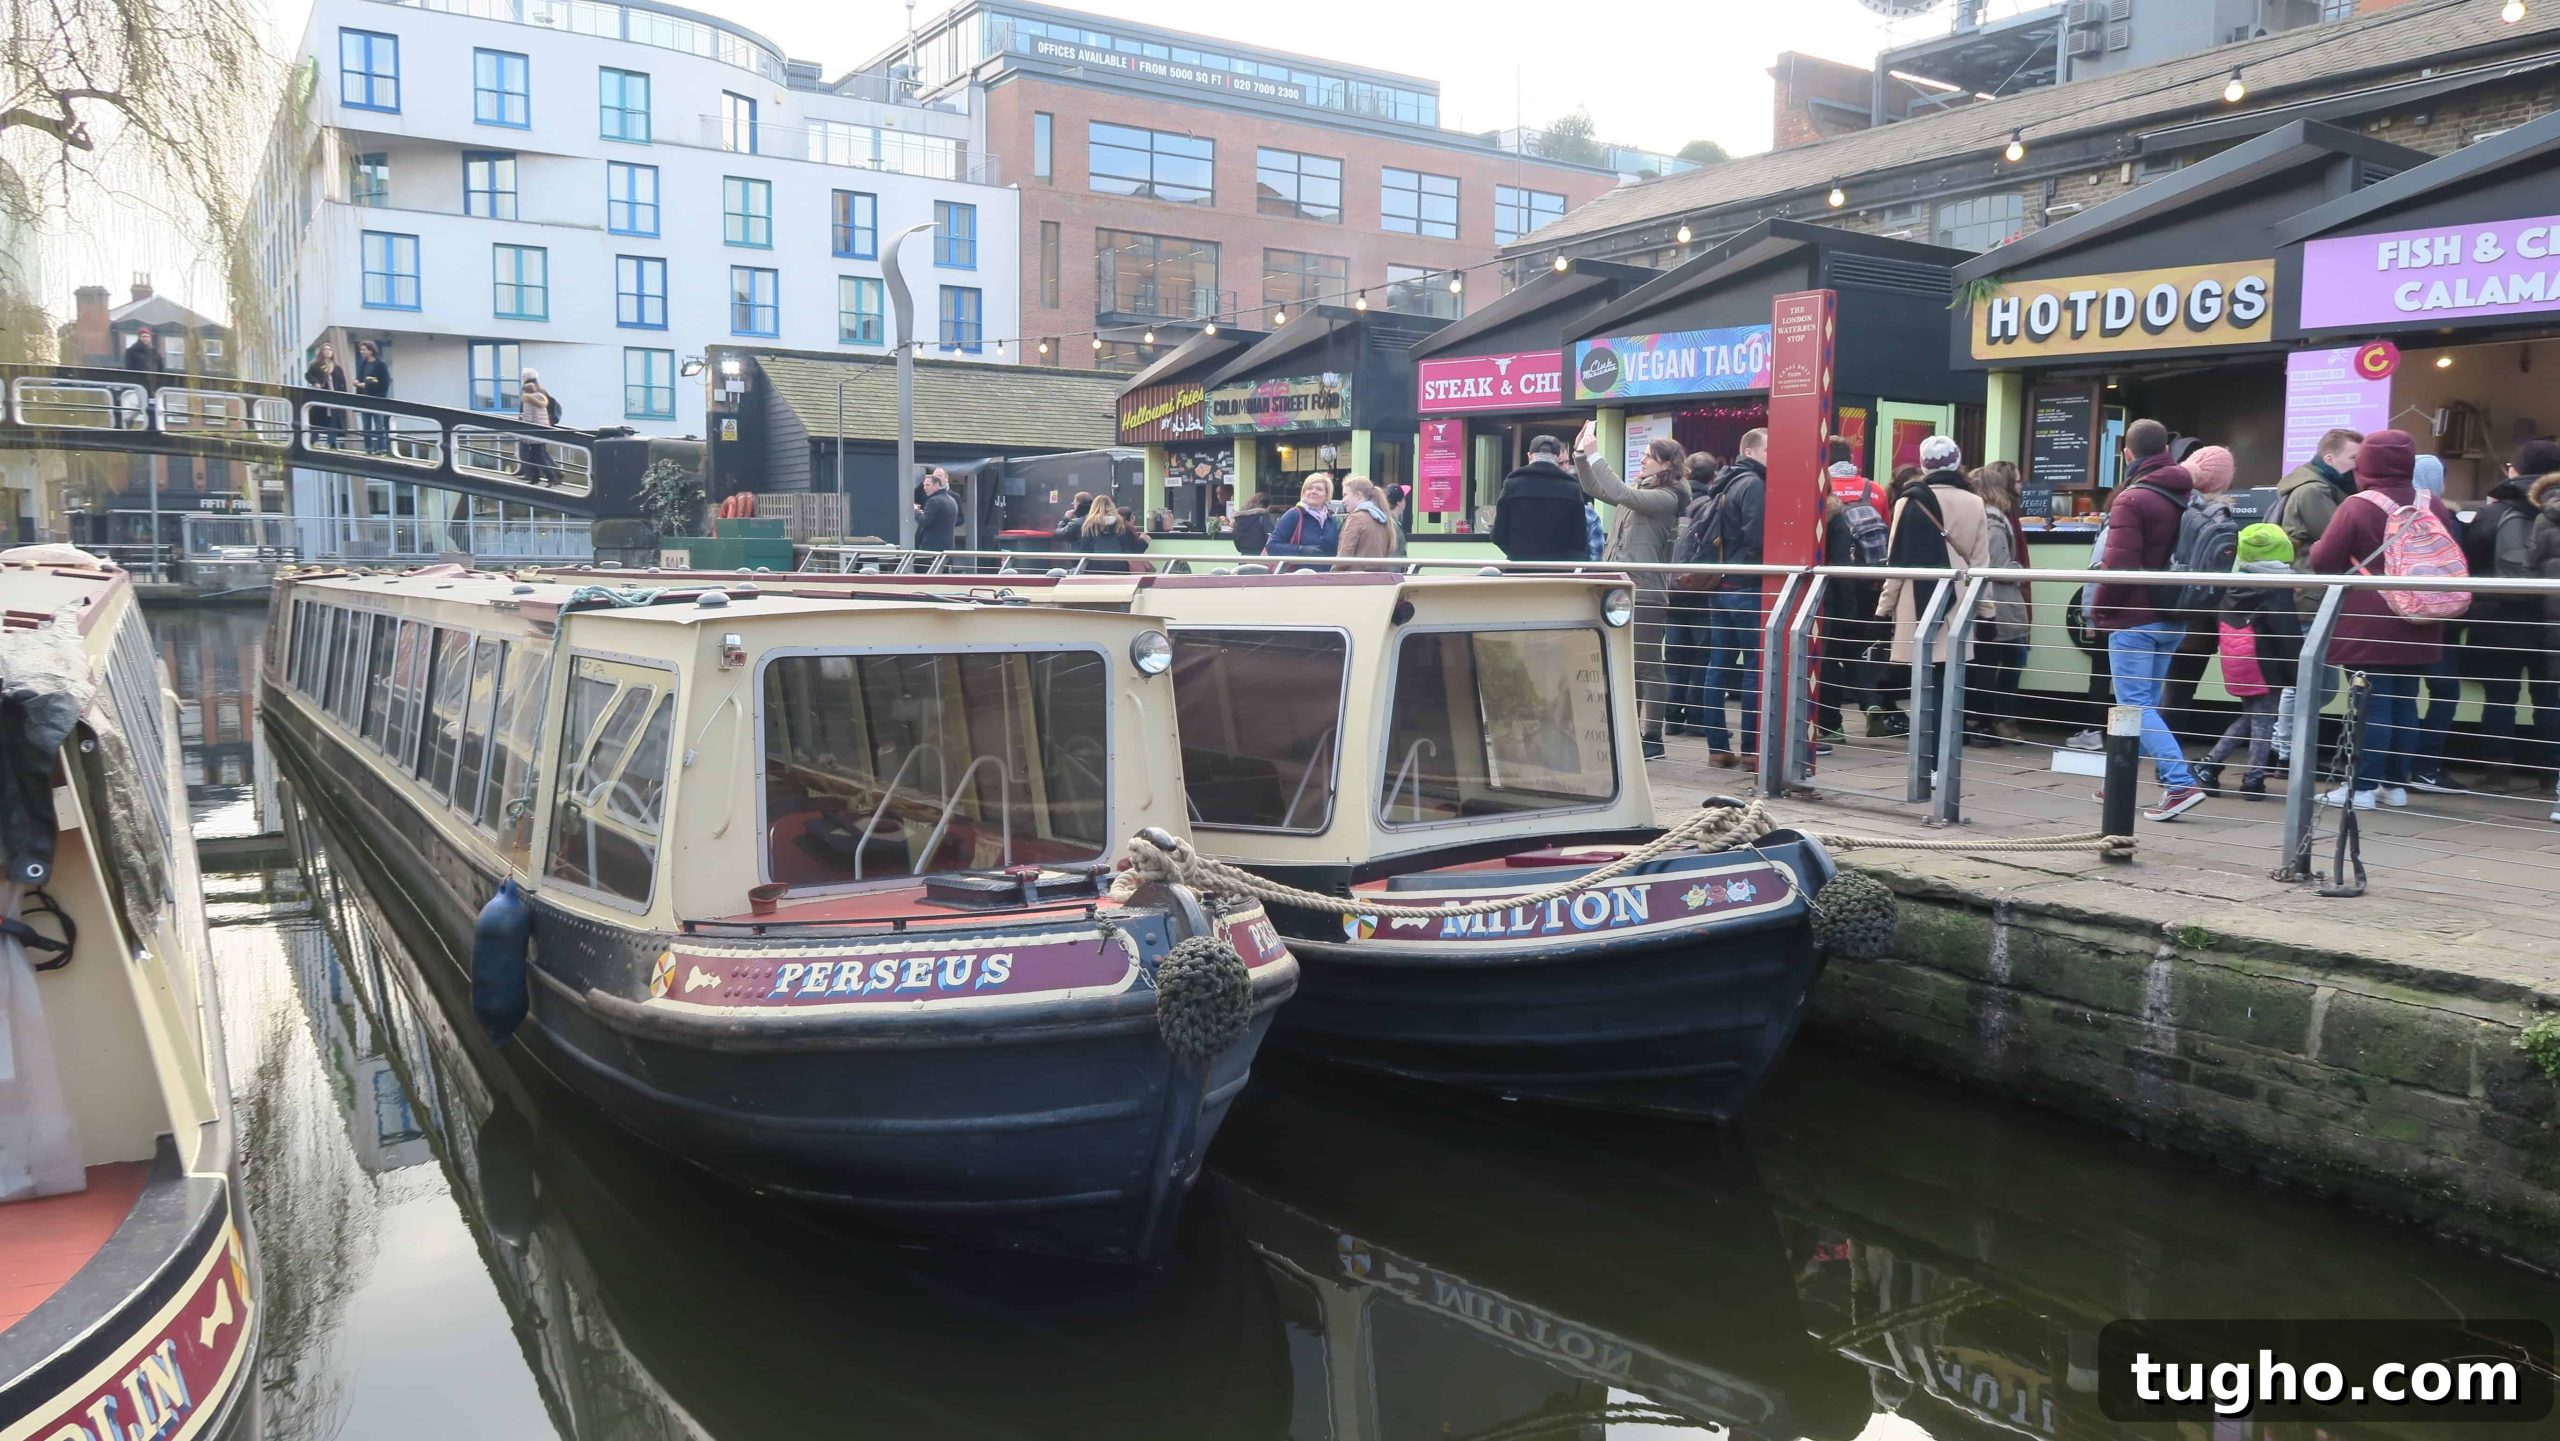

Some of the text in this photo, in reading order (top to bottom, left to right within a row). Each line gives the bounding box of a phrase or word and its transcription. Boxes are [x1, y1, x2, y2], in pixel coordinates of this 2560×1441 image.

[1037, 41, 1300, 100] OFFICES AVAILABLE FROM 5000 SQ FT 020 7009 2300
[2377, 235, 2462, 272] FISH
[2472, 231, 2507, 264] &
[1782, 315, 1813, 325] LONDON
[1790, 306, 1806, 315] THE
[1987, 275, 2267, 344] HOTDOGS
[1777, 324, 1817, 335] WATERBUS
[1786, 334, 1806, 343] STOP
[1590, 358, 1617, 373] Club
[1623, 348, 1696, 382] VEGAN
[1424, 377, 1494, 400] STEAK
[1500, 379, 1513, 396] &
[1120, 386, 1205, 432] Halloumi Fries
[1271, 394, 1310, 413] STREET
[2020, 499, 2049, 509] VEGGIE
[1440, 883, 1651, 938] MILTON
[768, 953, 1013, 998] PERSEUS
